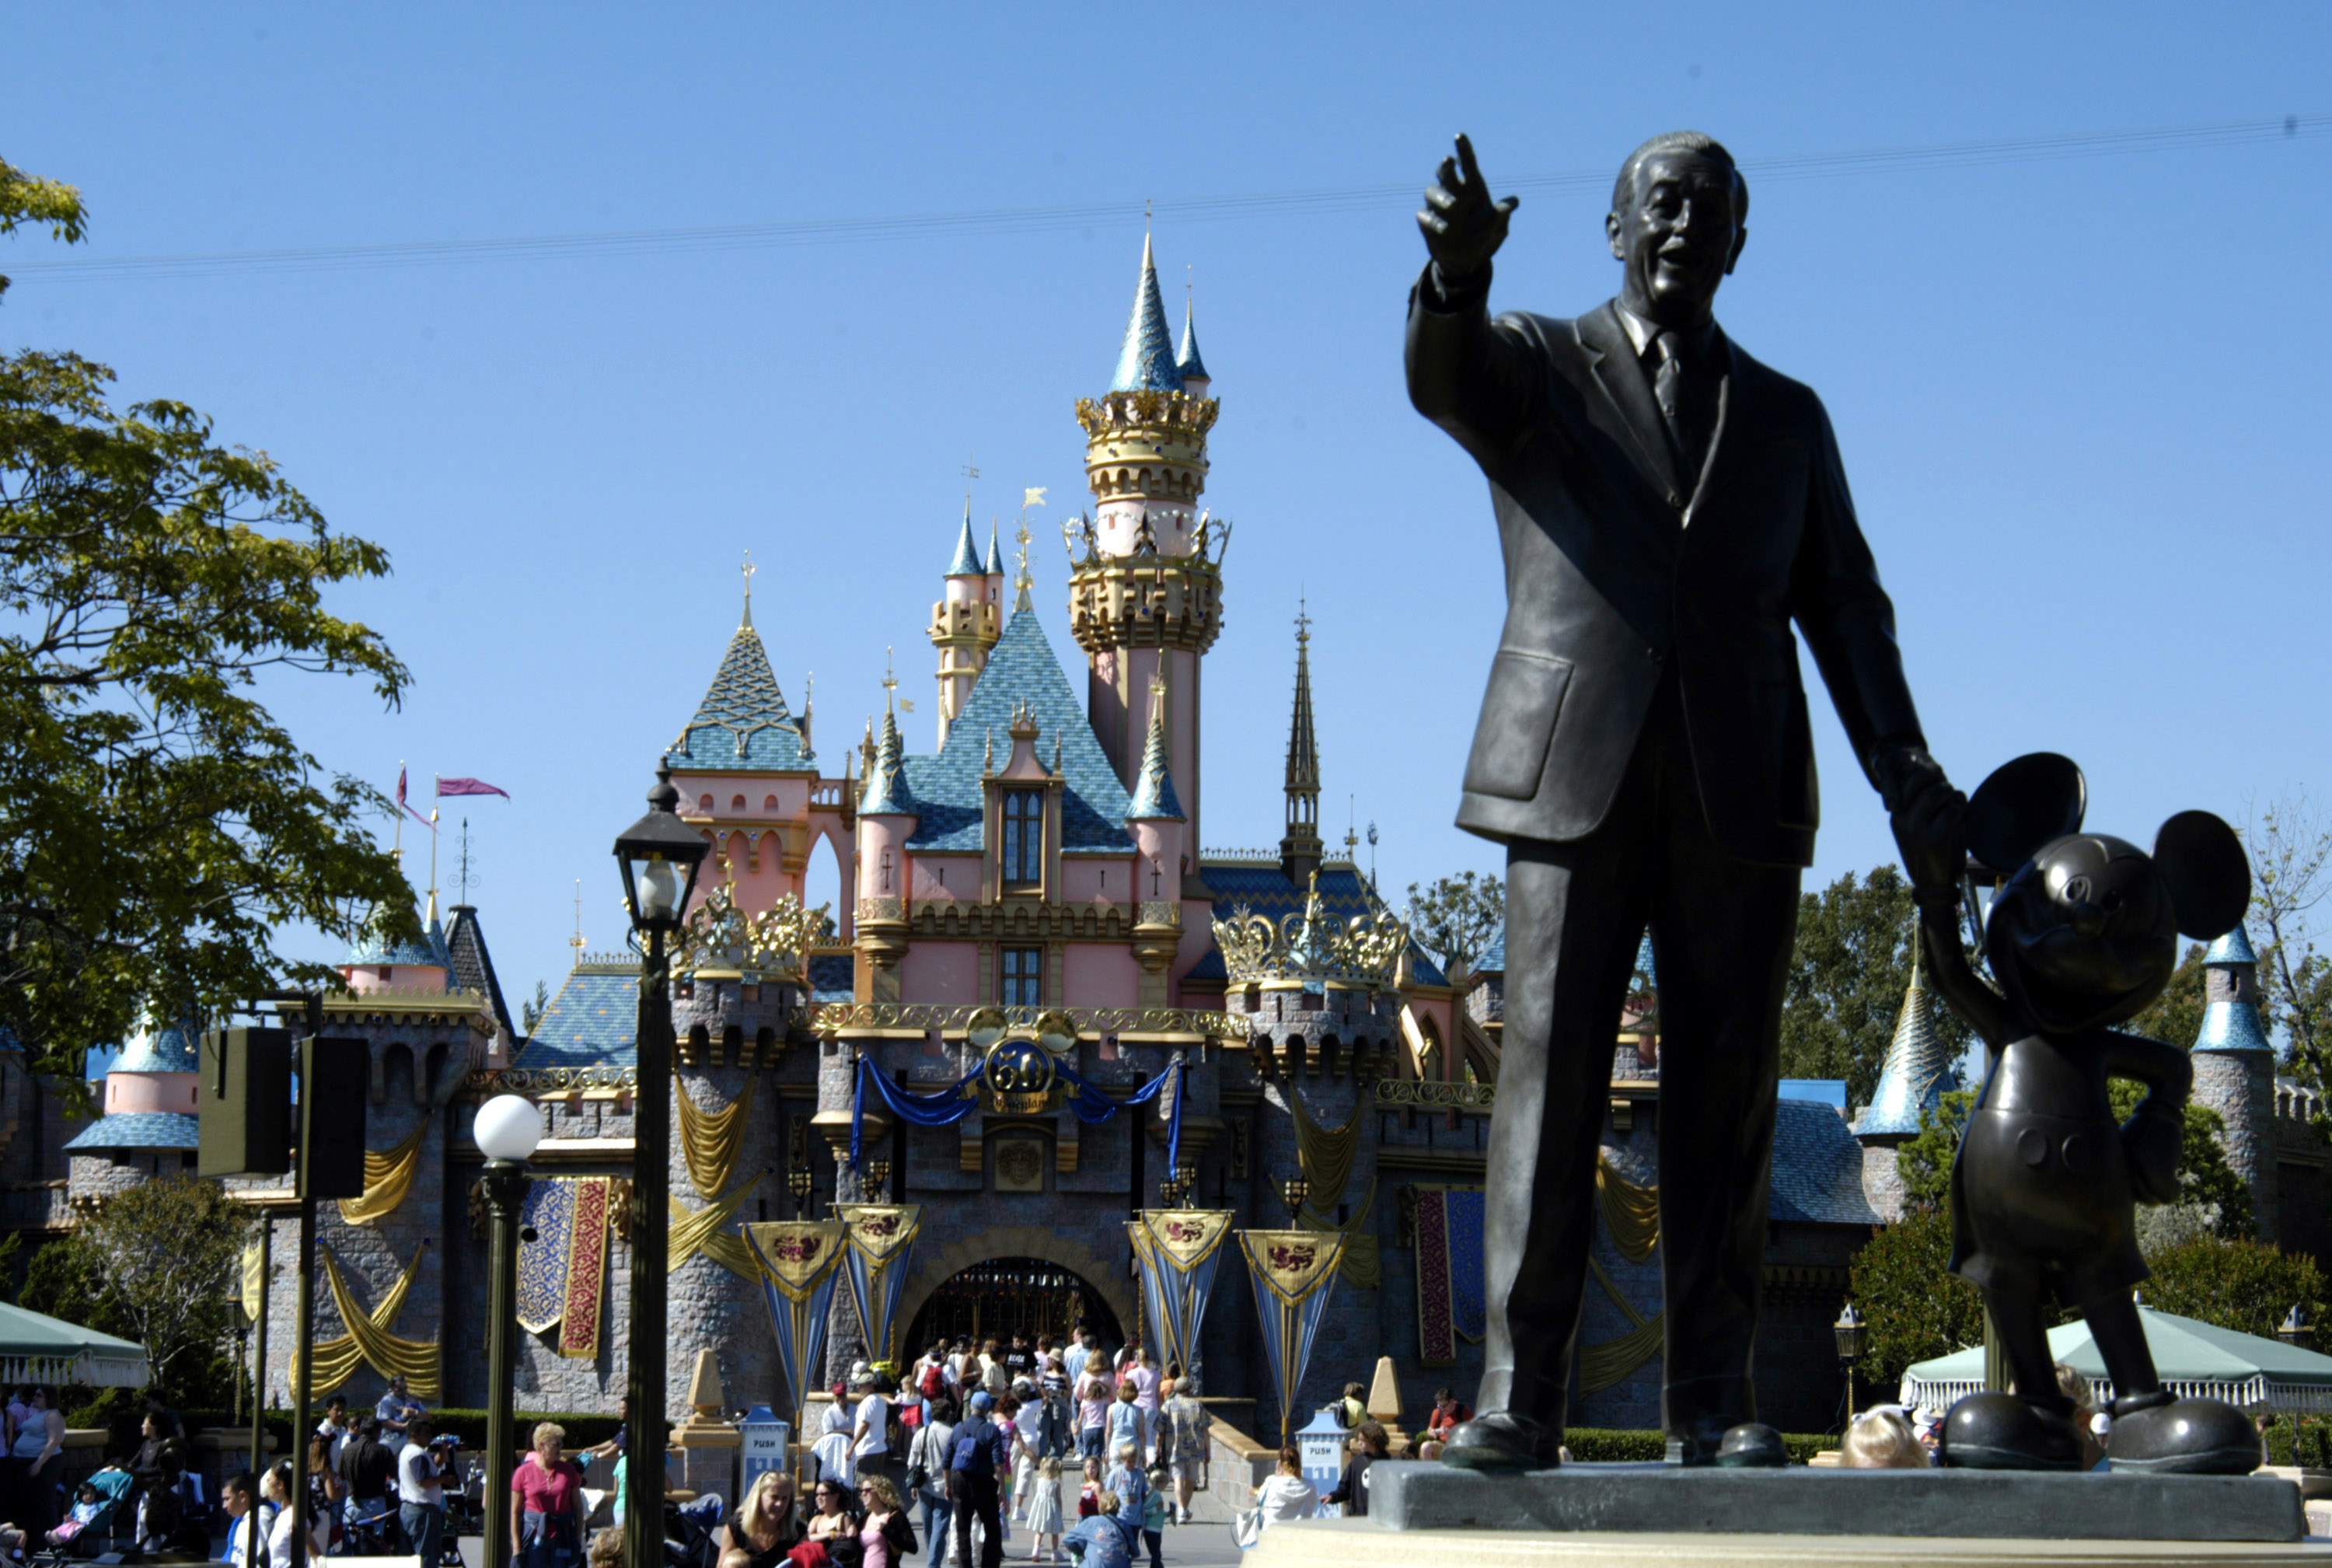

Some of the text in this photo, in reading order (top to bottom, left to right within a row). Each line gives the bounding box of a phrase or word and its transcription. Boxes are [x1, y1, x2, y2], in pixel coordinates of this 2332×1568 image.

[996, 1050, 1042, 1089] 50
[753, 1439, 776, 1448] PUSH
[1310, 1447, 1332, 1455] PUSH
